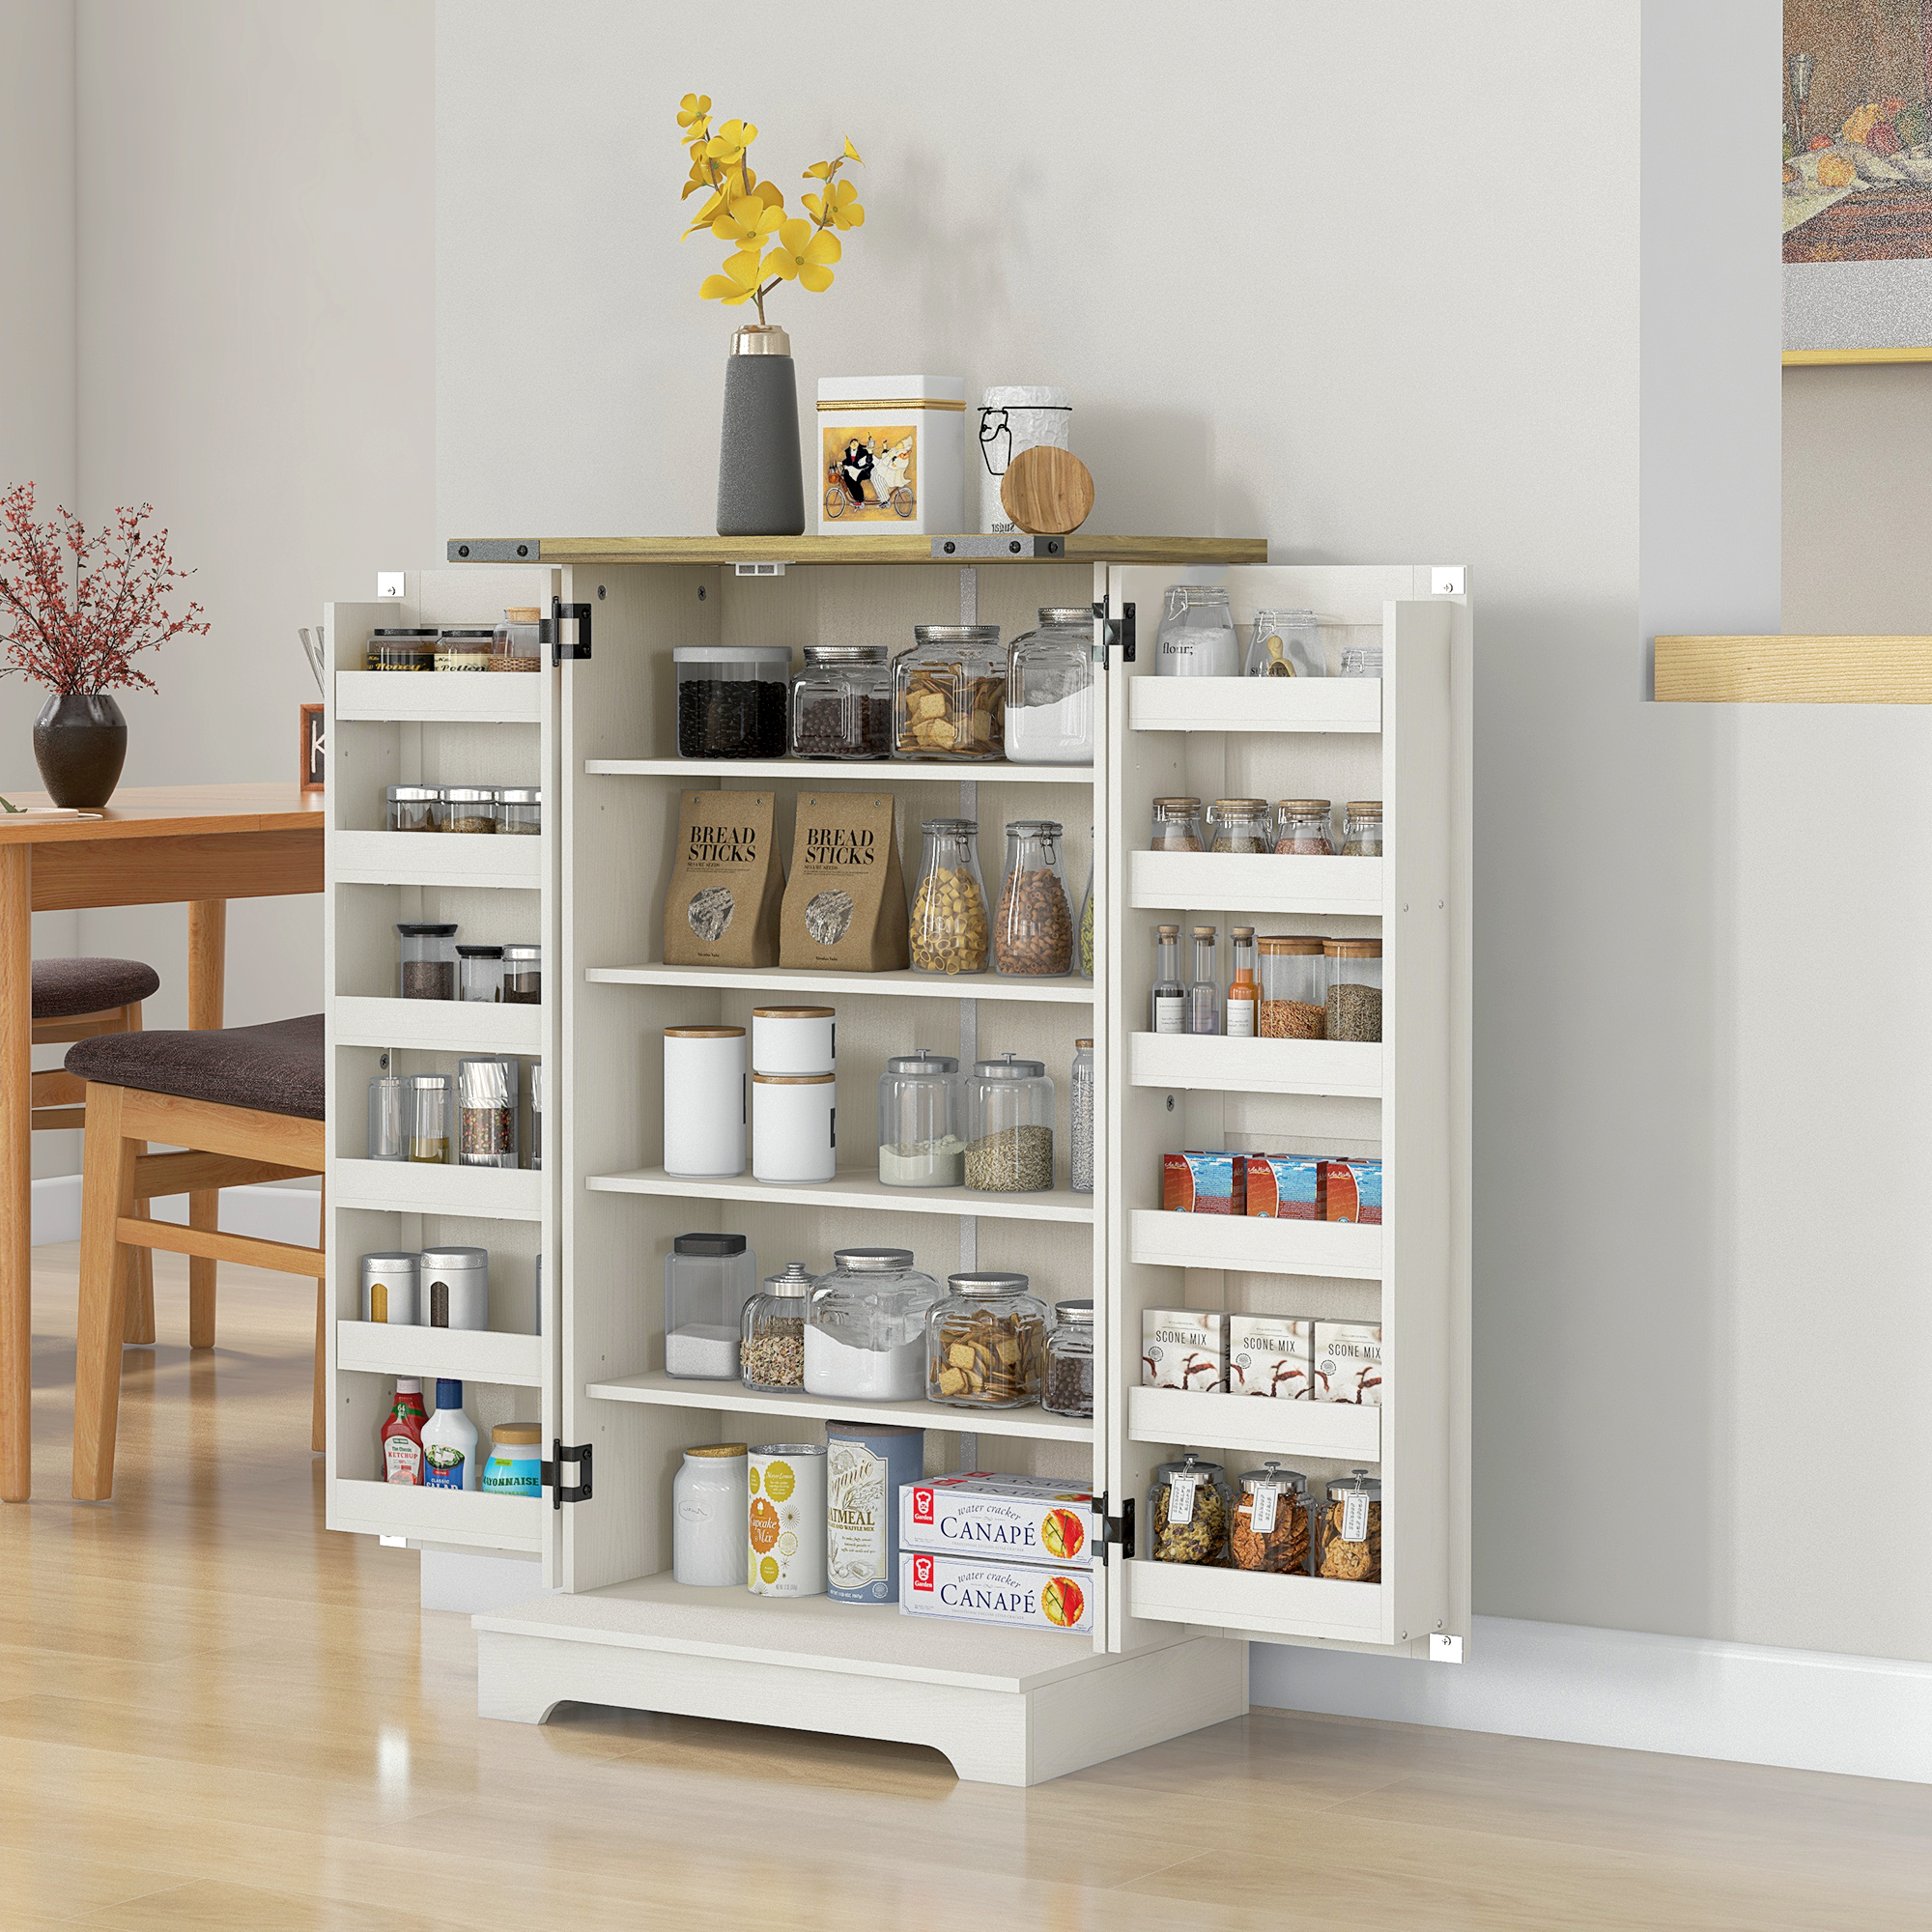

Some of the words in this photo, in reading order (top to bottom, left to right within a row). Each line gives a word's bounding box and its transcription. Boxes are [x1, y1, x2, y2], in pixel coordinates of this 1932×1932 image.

[689, 826, 755, 844] BREAD
[806, 828, 874, 847] BREAD
[688, 843, 756, 863] STICKS
[805, 846, 875, 865] STICKS
[1155, 1330, 1186, 1344] SCONE
[1190, 1333, 1207, 1346] MIX
[1243, 1337, 1274, 1350] SCONE
[1278, 1340, 1295, 1352] MIX
[1328, 1343, 1359, 1357] SCONE
[1364, 1347, 1381, 1359] MIX
[388, 1451, 418, 1460] KETCHUP
[914, 1513, 933, 1521] Garden
[958, 1504, 984, 1516] water
[986, 1505, 1021, 1520] cracker
[754, 1528, 773, 1544] Mix
[940, 1517, 1037, 1546] CANAPÉ
[958, 1572, 984, 1583] water
[986, 1573, 1021, 1588] cracker
[940, 1583, 1037, 1613] CANAPÉ
